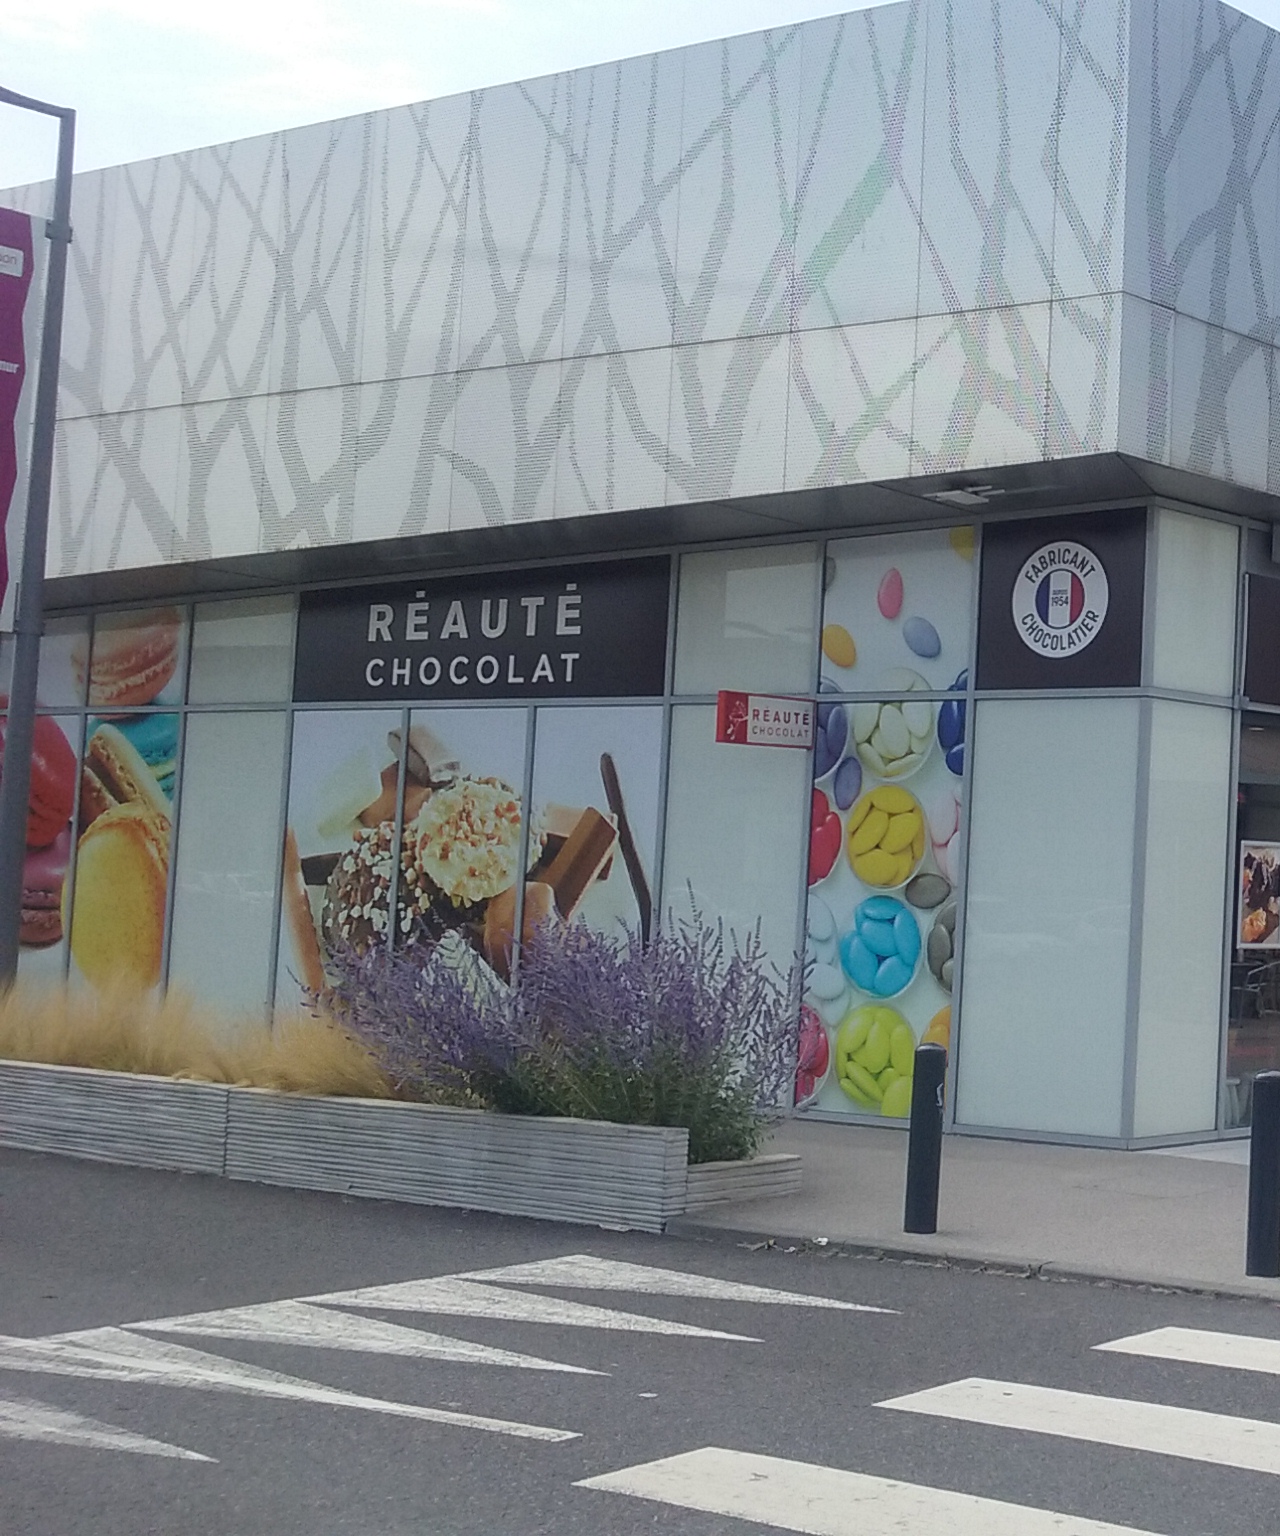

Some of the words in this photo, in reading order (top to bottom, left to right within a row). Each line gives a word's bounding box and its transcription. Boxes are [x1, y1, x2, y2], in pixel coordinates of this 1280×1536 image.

[1025, 548, 1096, 584] FABRICANT
[367, 583, 582, 642] RÉAUTÉ
[1021, 610, 1099, 651] CHOCOLATIER
[365, 653, 580, 687] CHOCOLAT
[751, 725, 809, 738] CHOCOLAT
[752, 706, 810, 726] RÉAUTÉ
